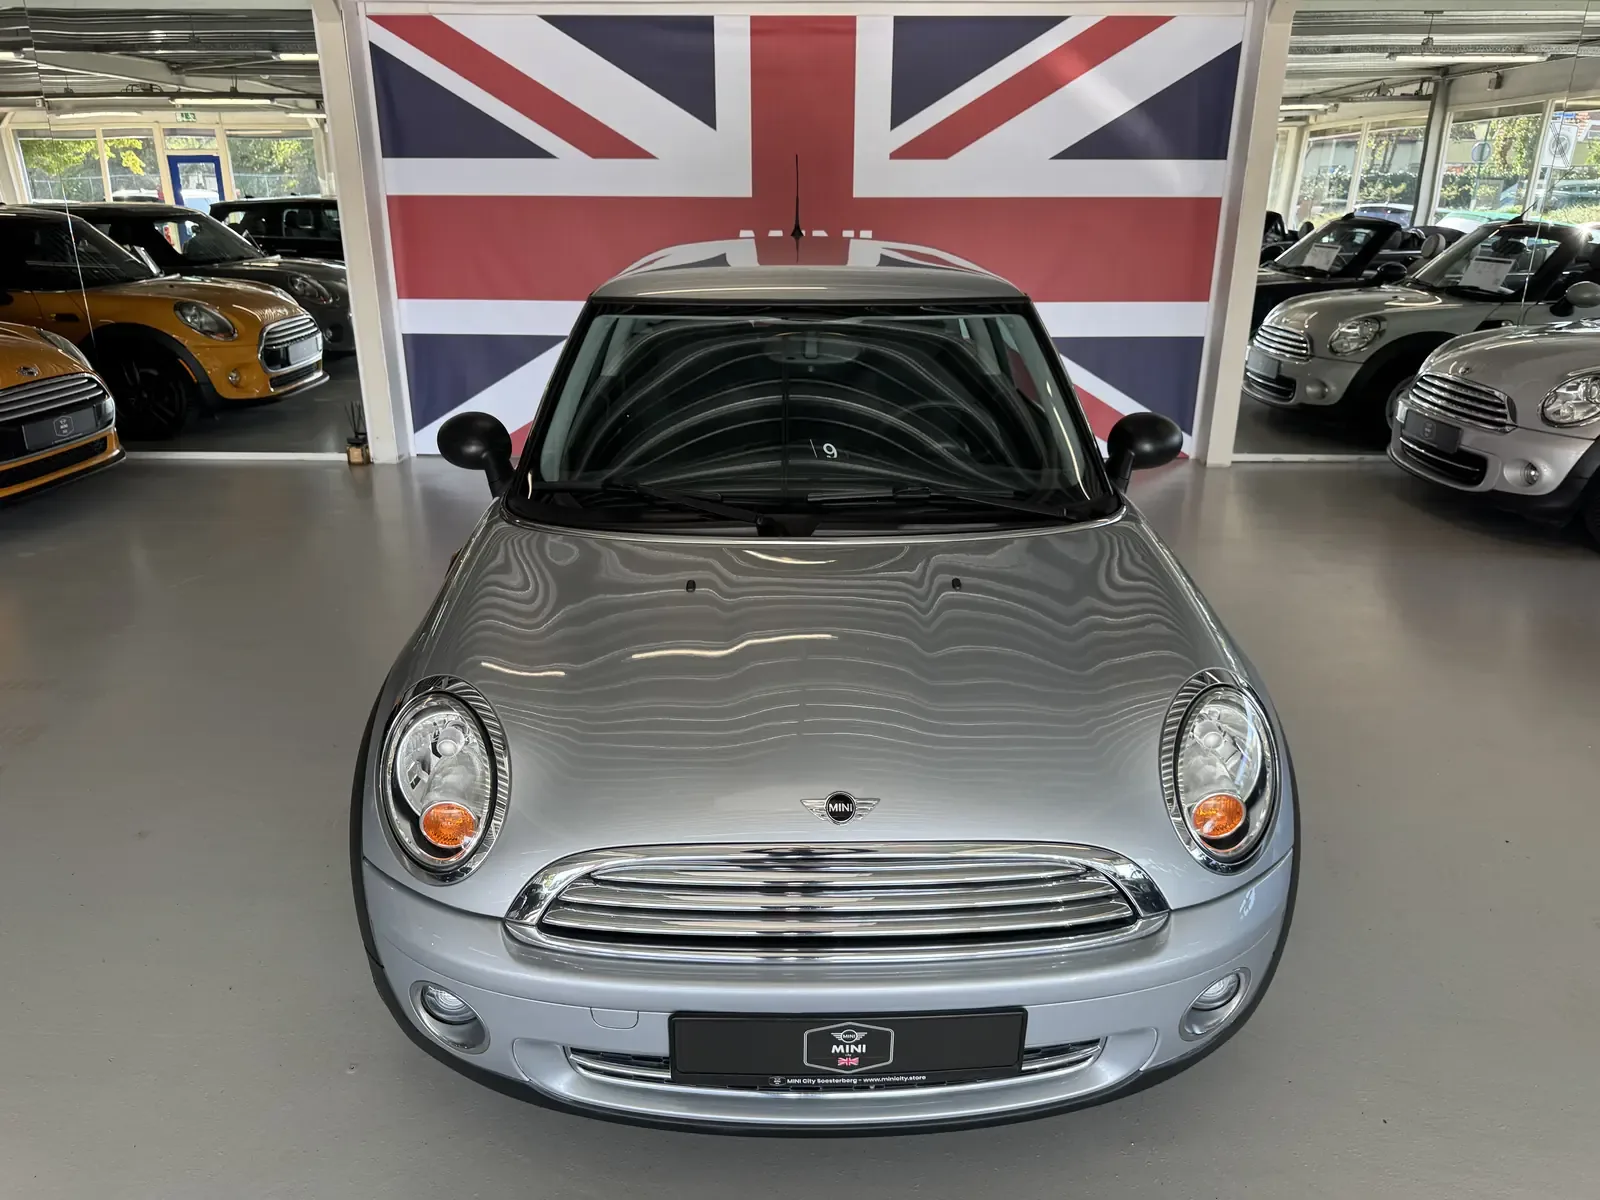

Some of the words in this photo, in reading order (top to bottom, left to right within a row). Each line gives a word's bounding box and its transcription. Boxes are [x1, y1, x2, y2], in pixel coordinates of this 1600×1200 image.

[828, 803, 853, 812] MINI
[831, 1044, 867, 1054] MINI
[863, 1075, 927, 1083] www.minicity.store
